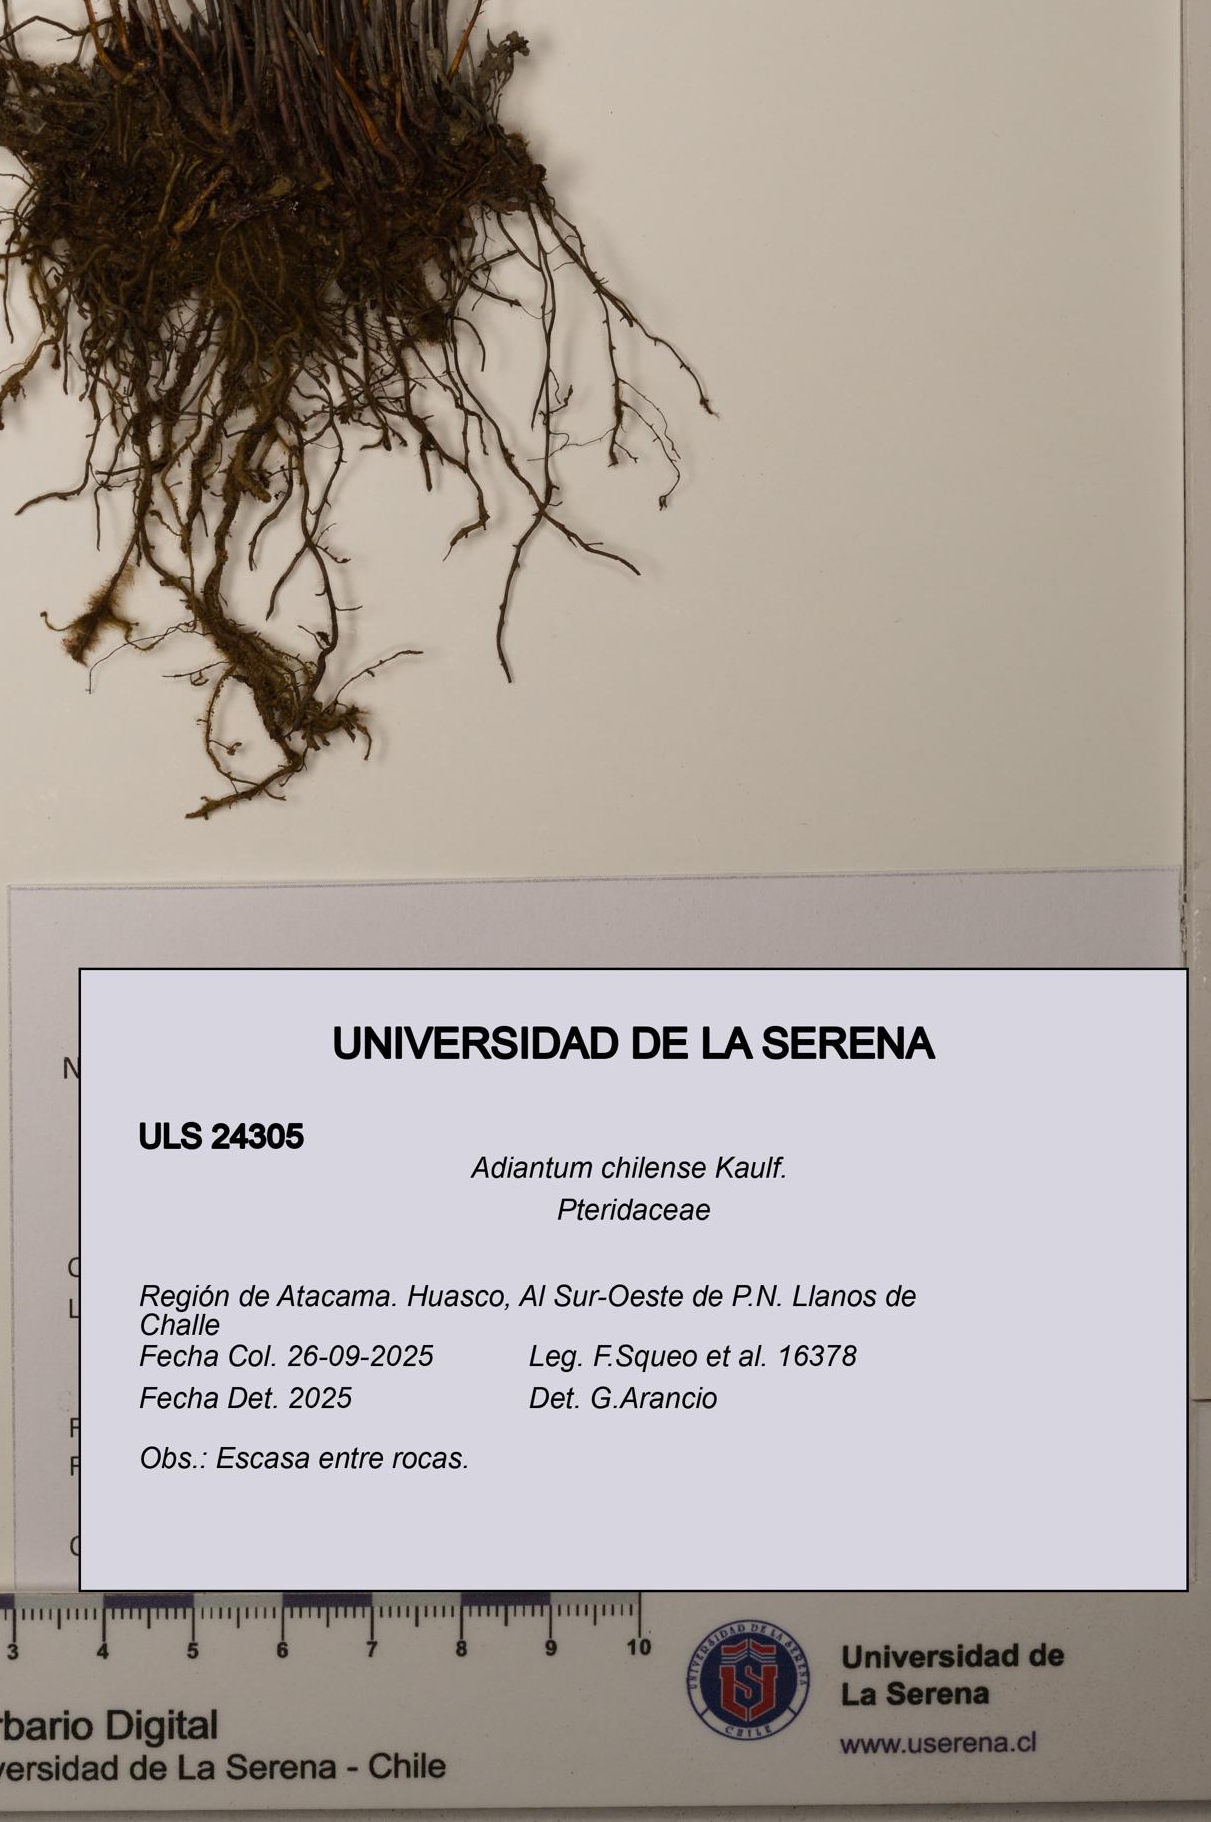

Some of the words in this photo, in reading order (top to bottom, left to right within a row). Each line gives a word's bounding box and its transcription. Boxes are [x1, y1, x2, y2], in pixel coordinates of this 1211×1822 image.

[7, 1643, 20, 1660] 3
[96, 1643, 109, 1660] 4
[187, 1642, 199, 1659] 5
[276, 1642, 289, 1659] 6
[366, 1641, 378, 1658] 7
[455, 1640, 467, 1657] 8
[545, 1640, 557, 1657] 9
[628, 1640, 651, 1656] 10
[842, 1643, 1019, 1669] Universidad
[1029, 1643, 1064, 1667] de
[842, 1682, 876, 1706] La
[886, 1681, 989, 1706] Serena
[107, 1709, 218, 1746] Digital
[840, 1731, 1037, 1755] www.userena.cl
[130, 1755, 167, 1781] de
[179, 1754, 215, 1780] La
[226, 1754, 336, 1780] Serena
[369, 1752, 446, 1779] Chile
